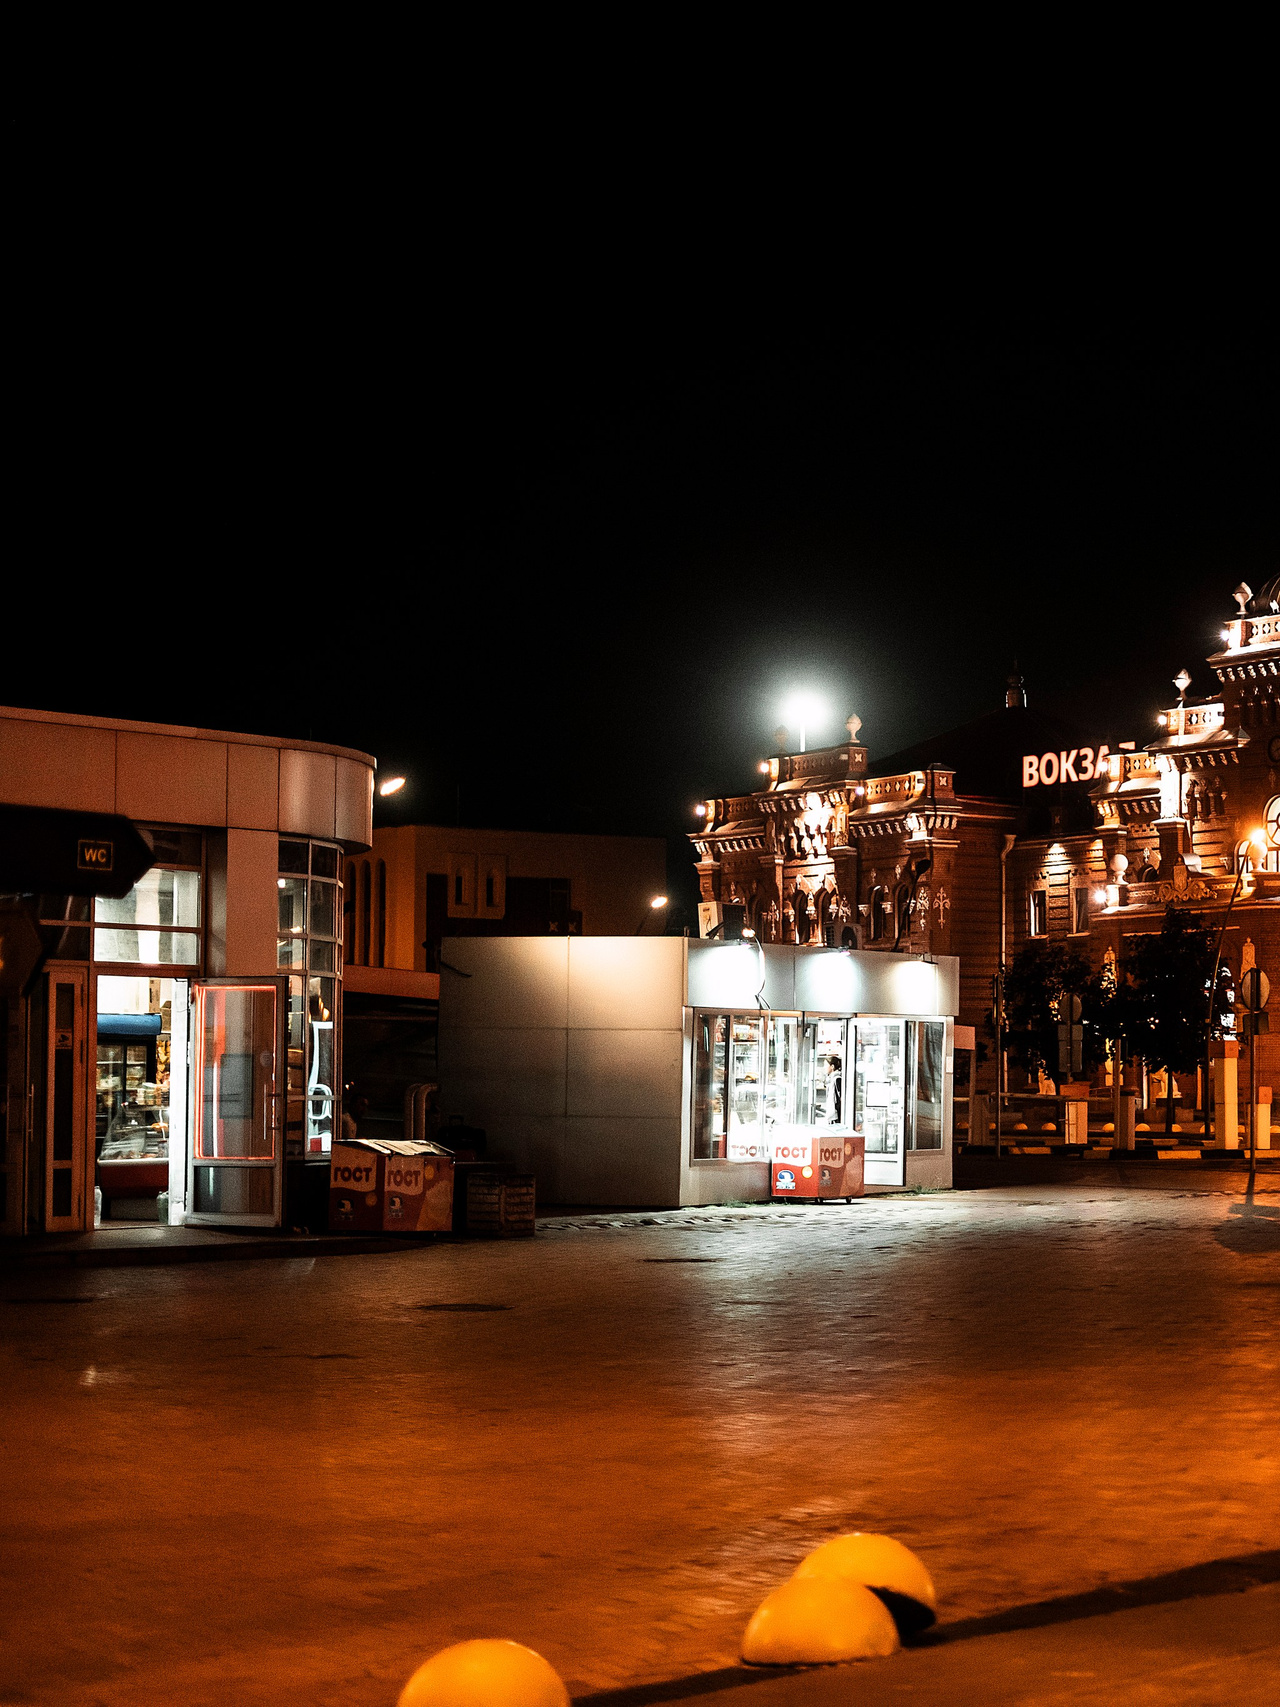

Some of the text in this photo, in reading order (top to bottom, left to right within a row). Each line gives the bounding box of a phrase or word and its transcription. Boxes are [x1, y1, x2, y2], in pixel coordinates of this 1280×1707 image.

[84, 847, 107, 863] WC
[775, 1146, 807, 1158] ГОСТ
[820, 1147, 842, 1161] ГОСТ
[333, 1166, 372, 1182] ГОСТ
[388, 1169, 420, 1187] ГОСТ
